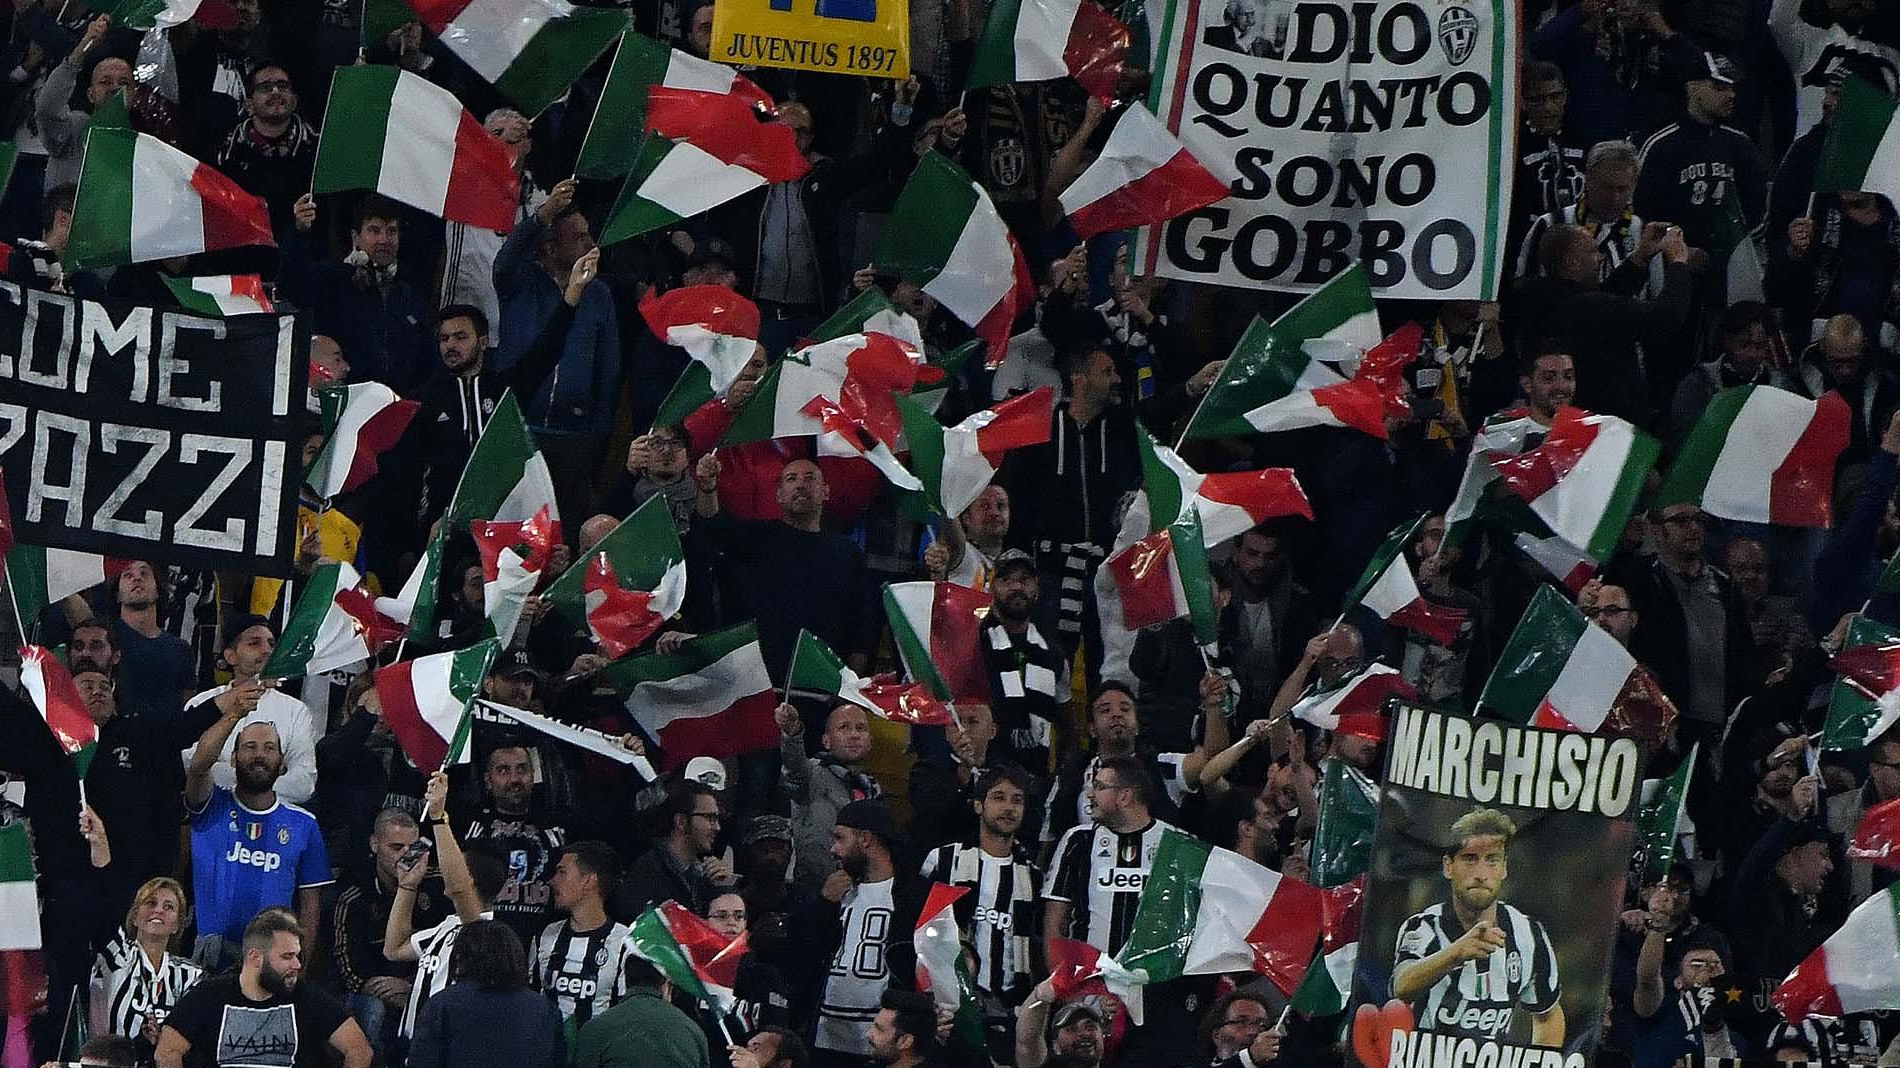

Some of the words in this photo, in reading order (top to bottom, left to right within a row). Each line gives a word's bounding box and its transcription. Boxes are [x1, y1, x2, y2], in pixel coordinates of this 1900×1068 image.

[726, 32, 839, 70] JUVENTUS
[845, 46, 897, 74] 1897
[1287, 1, 1432, 67] DIO
[1192, 62, 1493, 139] QUANTO
[1230, 148, 1438, 210] SONO
[1163, 207, 1477, 292] GOBBO
[271, 314, 296, 417] I
[1388, 704, 1638, 819] MARCHISIO
[226, 841, 281, 873] Jeep
[1098, 868, 1143, 889] Jee
[551, 969, 598, 1000] Jeep
